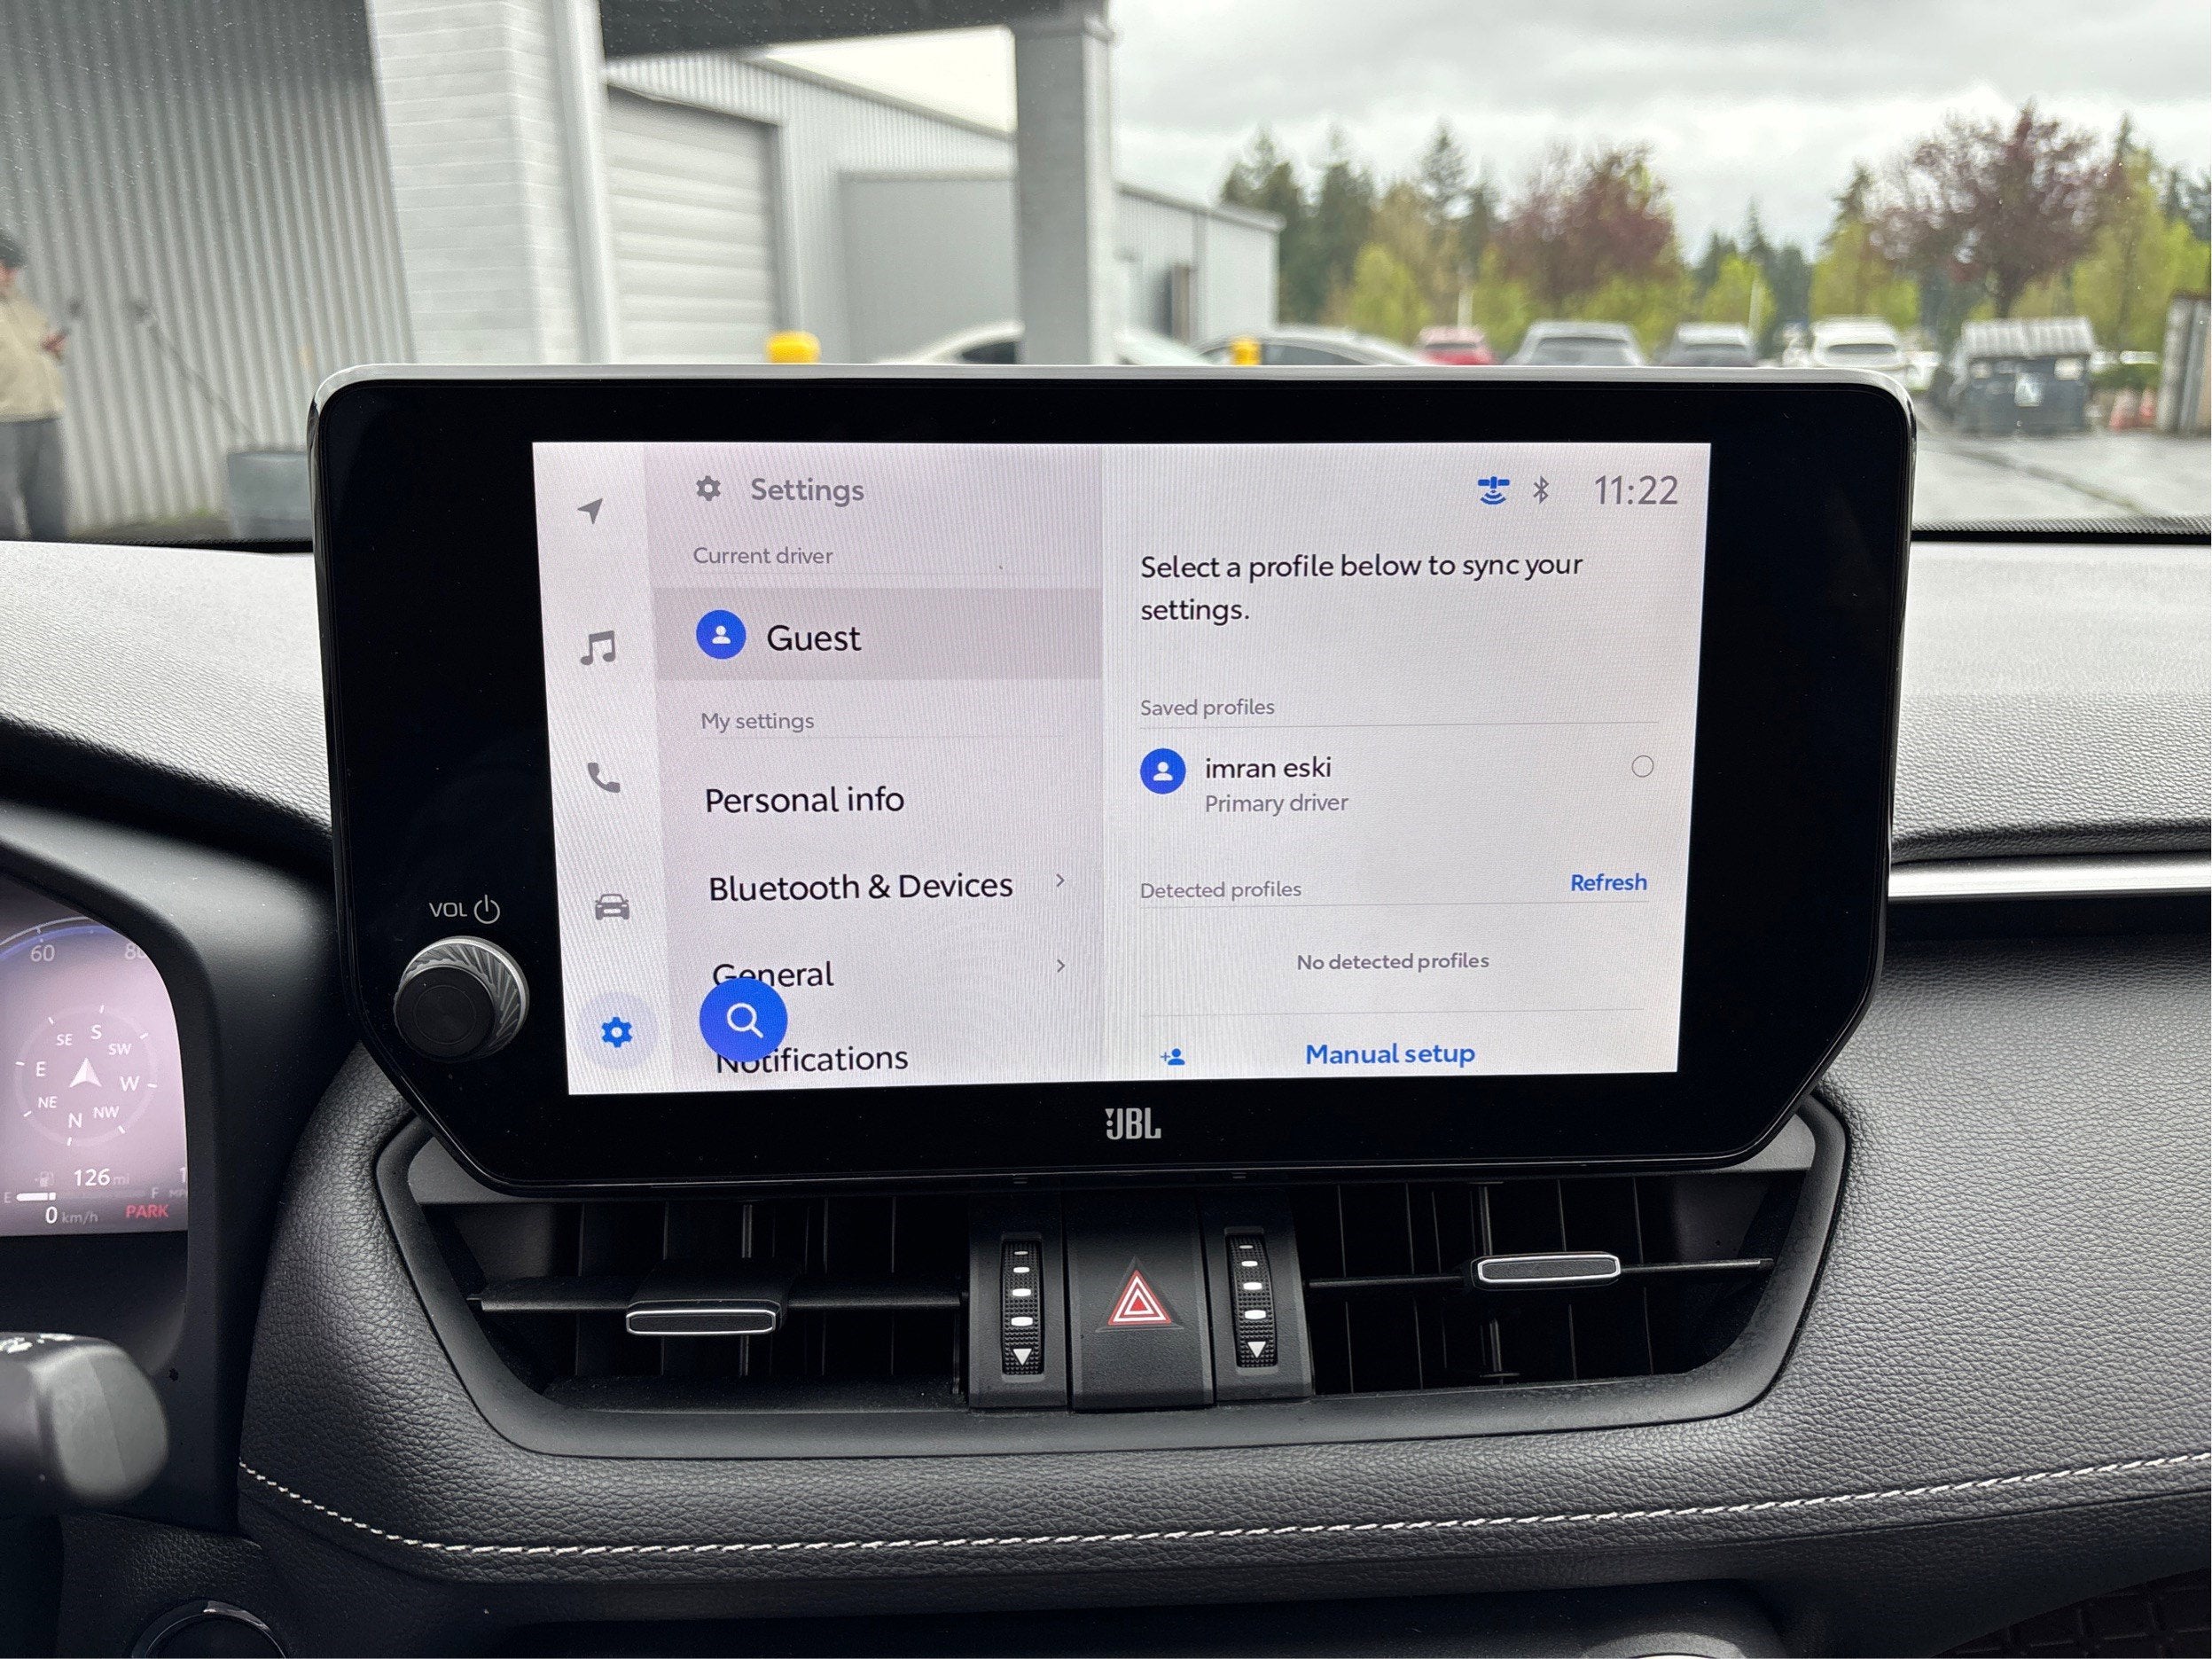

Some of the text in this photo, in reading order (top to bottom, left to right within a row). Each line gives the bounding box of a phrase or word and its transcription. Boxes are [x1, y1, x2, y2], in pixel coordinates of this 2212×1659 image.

[751, 477, 864, 507] Settings
[1595, 475, 1678, 505] 11:22
[693, 547, 833, 566] Current driver
[1141, 554, 1583, 583] Select a profile below to sync your
[1141, 599, 1250, 626] settings.
[767, 624, 862, 652] Guest
[1141, 698, 1275, 719] Saved profiles
[701, 712, 815, 733] My settings
[1205, 756, 1332, 779] imran eski
[706, 786, 905, 813] Personal info
[1205, 792, 1348, 817] Primary driver
[709, 873, 1013, 903] Bluetooth & Devices
[1141, 880, 1301, 902] Detected profiles
[1571, 873, 1647, 892] Refresh
[428, 902, 468, 918] VOL
[30, 944, 55, 962] 60
[1297, 952, 1489, 973] No detected profiles
[56, 1033, 74, 1046] SE
[90, 1024, 102, 1040] S
[108, 1043, 132, 1056] SW
[1306, 1044, 1476, 1068] Manual setup
[35, 1061, 46, 1077] E
[120, 1076, 140, 1092] W
[38, 1096, 58, 1108] NE
[68, 1113, 82, 1128] N
[93, 1106, 120, 1119] NW
[1105, 1107, 1161, 1139] JBL
[74, 1169, 110, 1186] 126
[46, 1206, 98, 1225] 0 km/h
[126, 1204, 168, 1218] PARK
